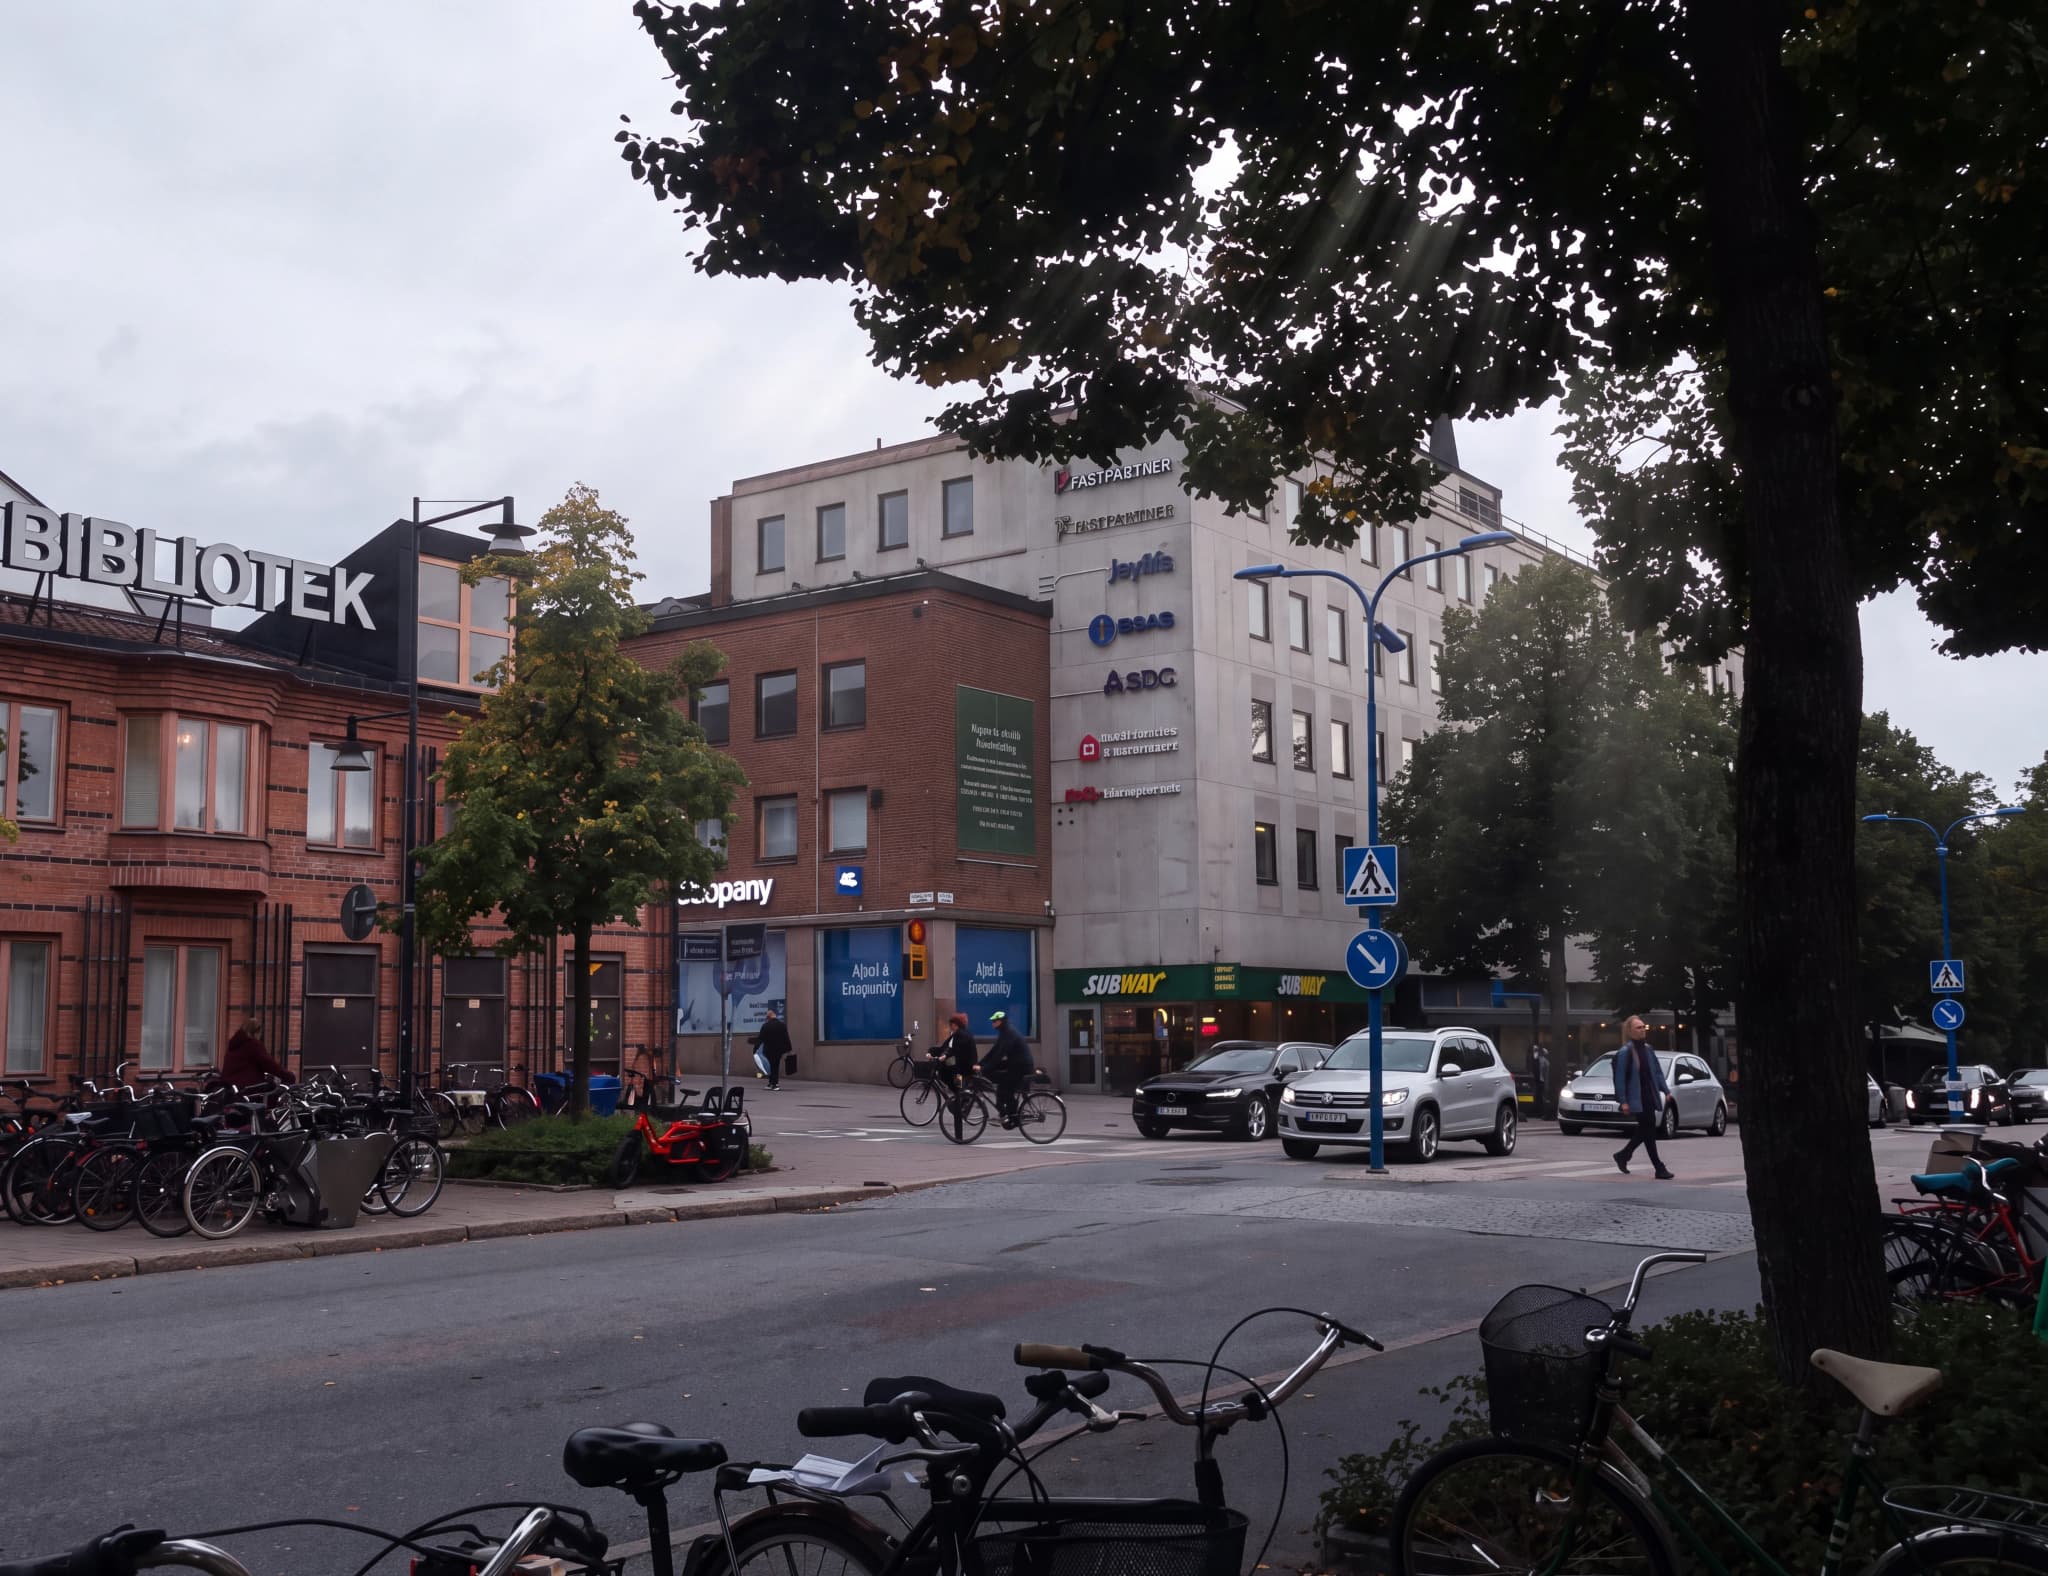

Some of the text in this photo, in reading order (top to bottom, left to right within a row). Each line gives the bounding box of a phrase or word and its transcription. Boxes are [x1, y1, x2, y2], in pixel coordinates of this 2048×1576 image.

[4, 499, 376, 632] BIBLIOTEK
[1083, 971, 1167, 996] SUBWAY
[1278, 975, 1327, 996] SUBWAY
